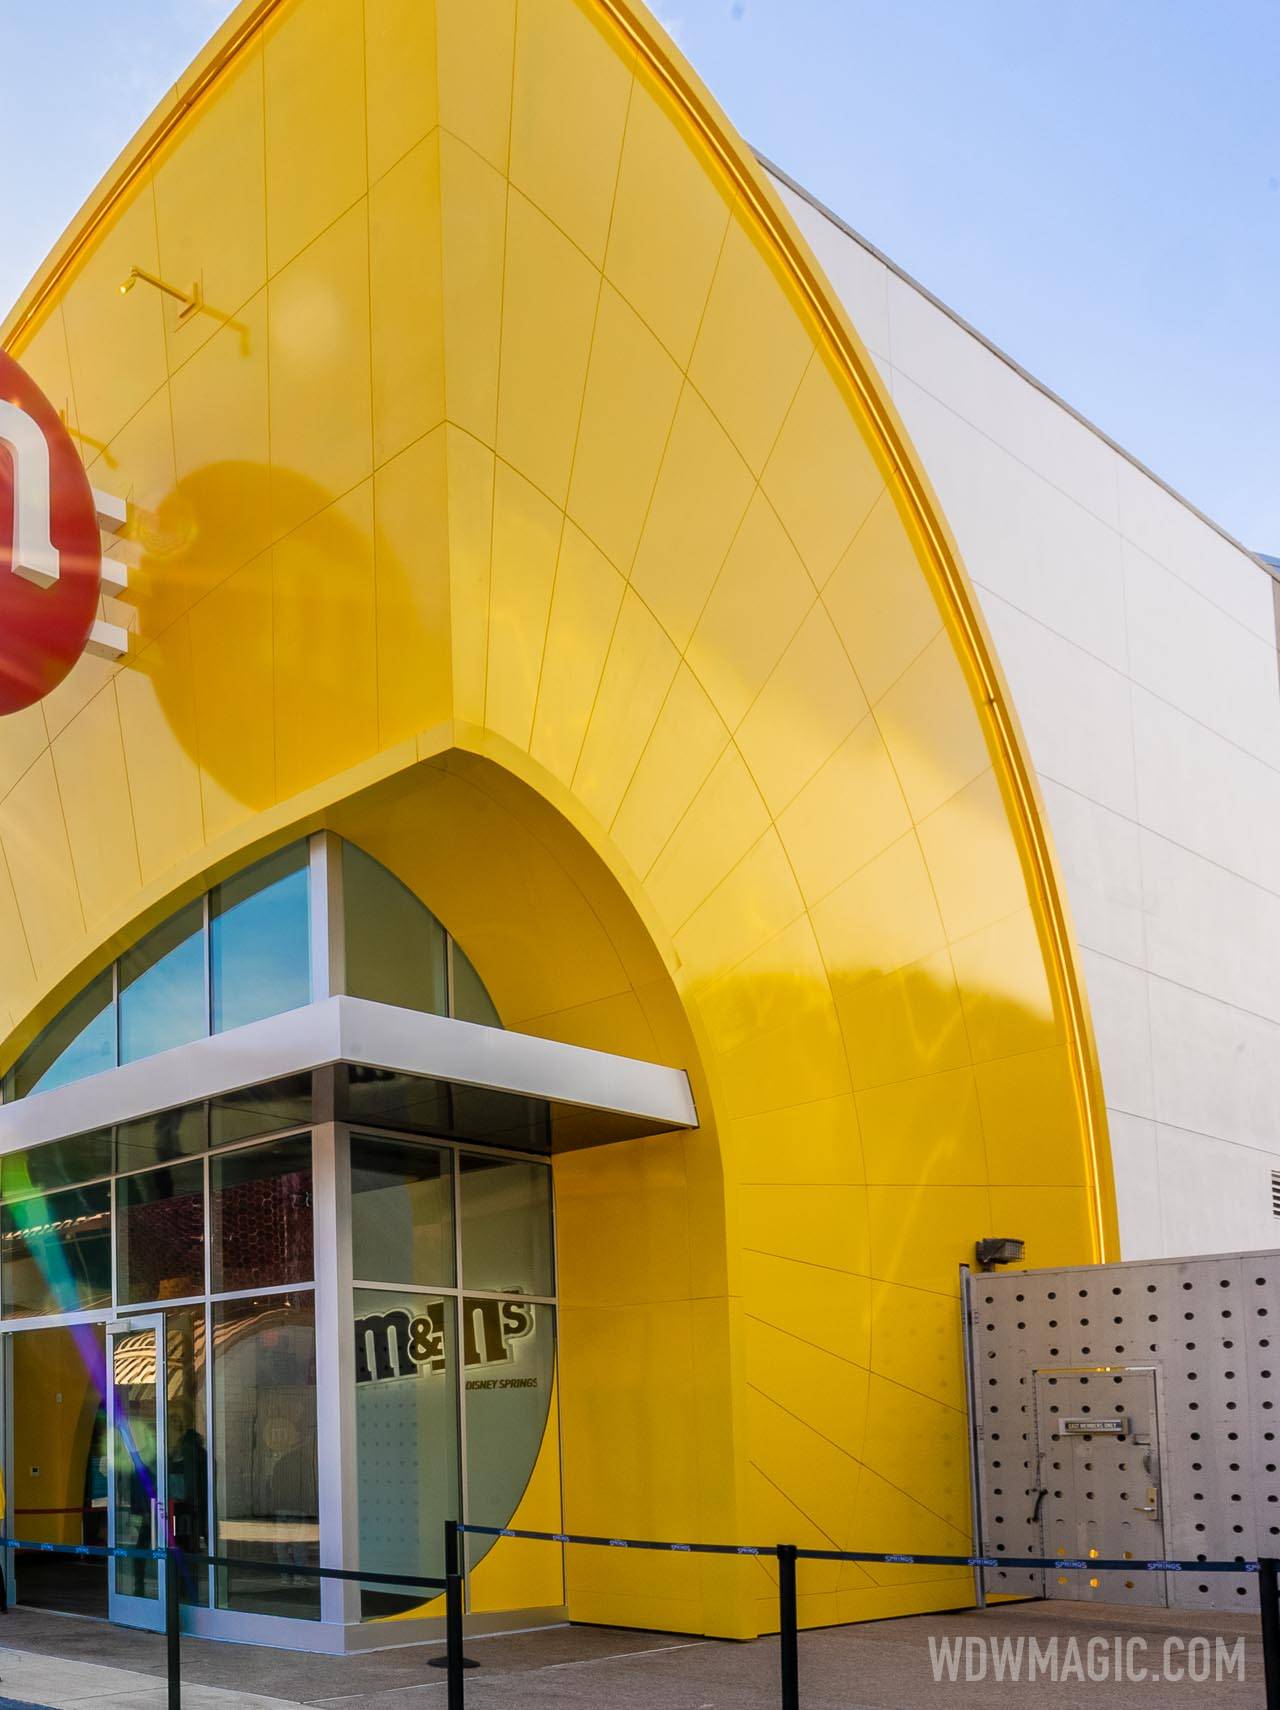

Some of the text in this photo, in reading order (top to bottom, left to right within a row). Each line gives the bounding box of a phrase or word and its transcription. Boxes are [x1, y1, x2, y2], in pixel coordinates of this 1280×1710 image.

[465, 1377, 538, 1391] DISNEY SPRINGS
[1055, 1561, 1087, 1569] SPRINGS
[1147, 1562, 1182, 1570] SPRINGS
